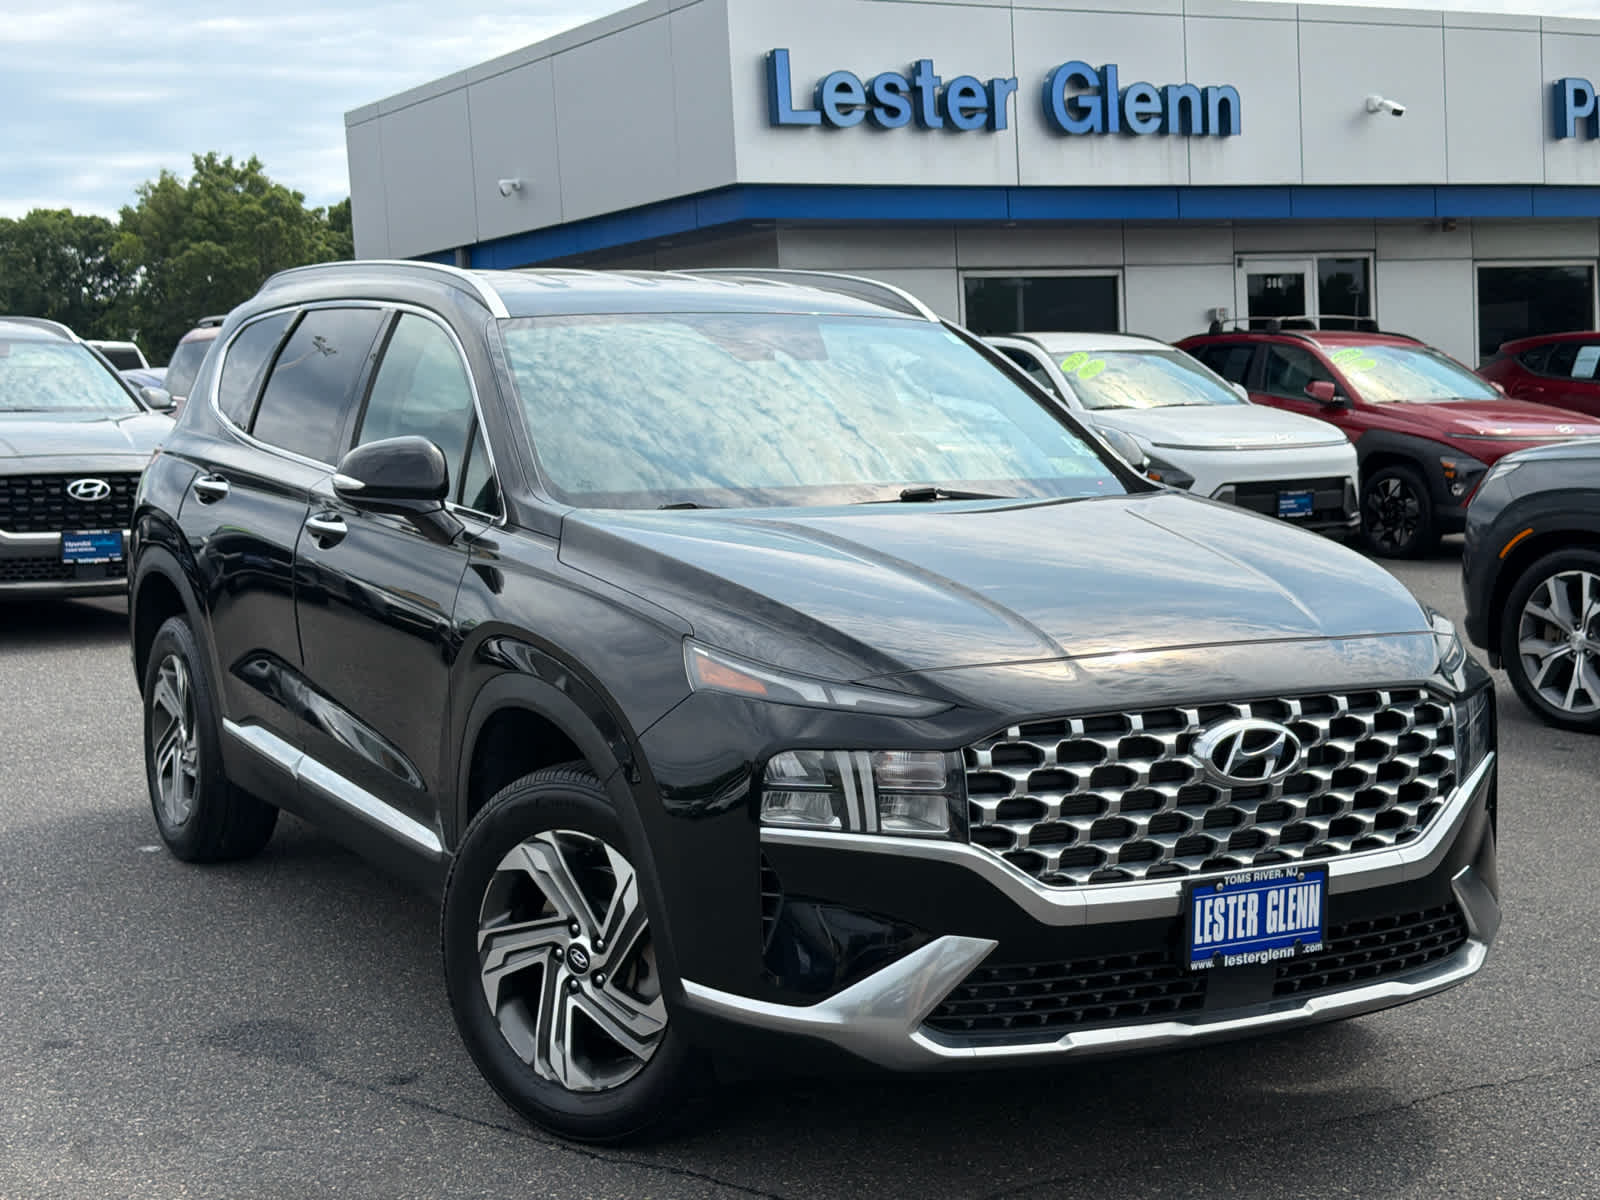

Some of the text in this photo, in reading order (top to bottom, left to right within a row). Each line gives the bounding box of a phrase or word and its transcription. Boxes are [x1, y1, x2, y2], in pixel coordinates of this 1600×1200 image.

[766, 48, 1241, 137] Lester Glenn
[1553, 77, 1600, 140] P
[1224, 871, 1251, 886] TOMS
[1286, 866, 1299, 877] NJ
[1194, 883, 1321, 945] LESTER GLENN
[1190, 959, 1215, 971] www.
[1224, 947, 1295, 968] lesterglenn
